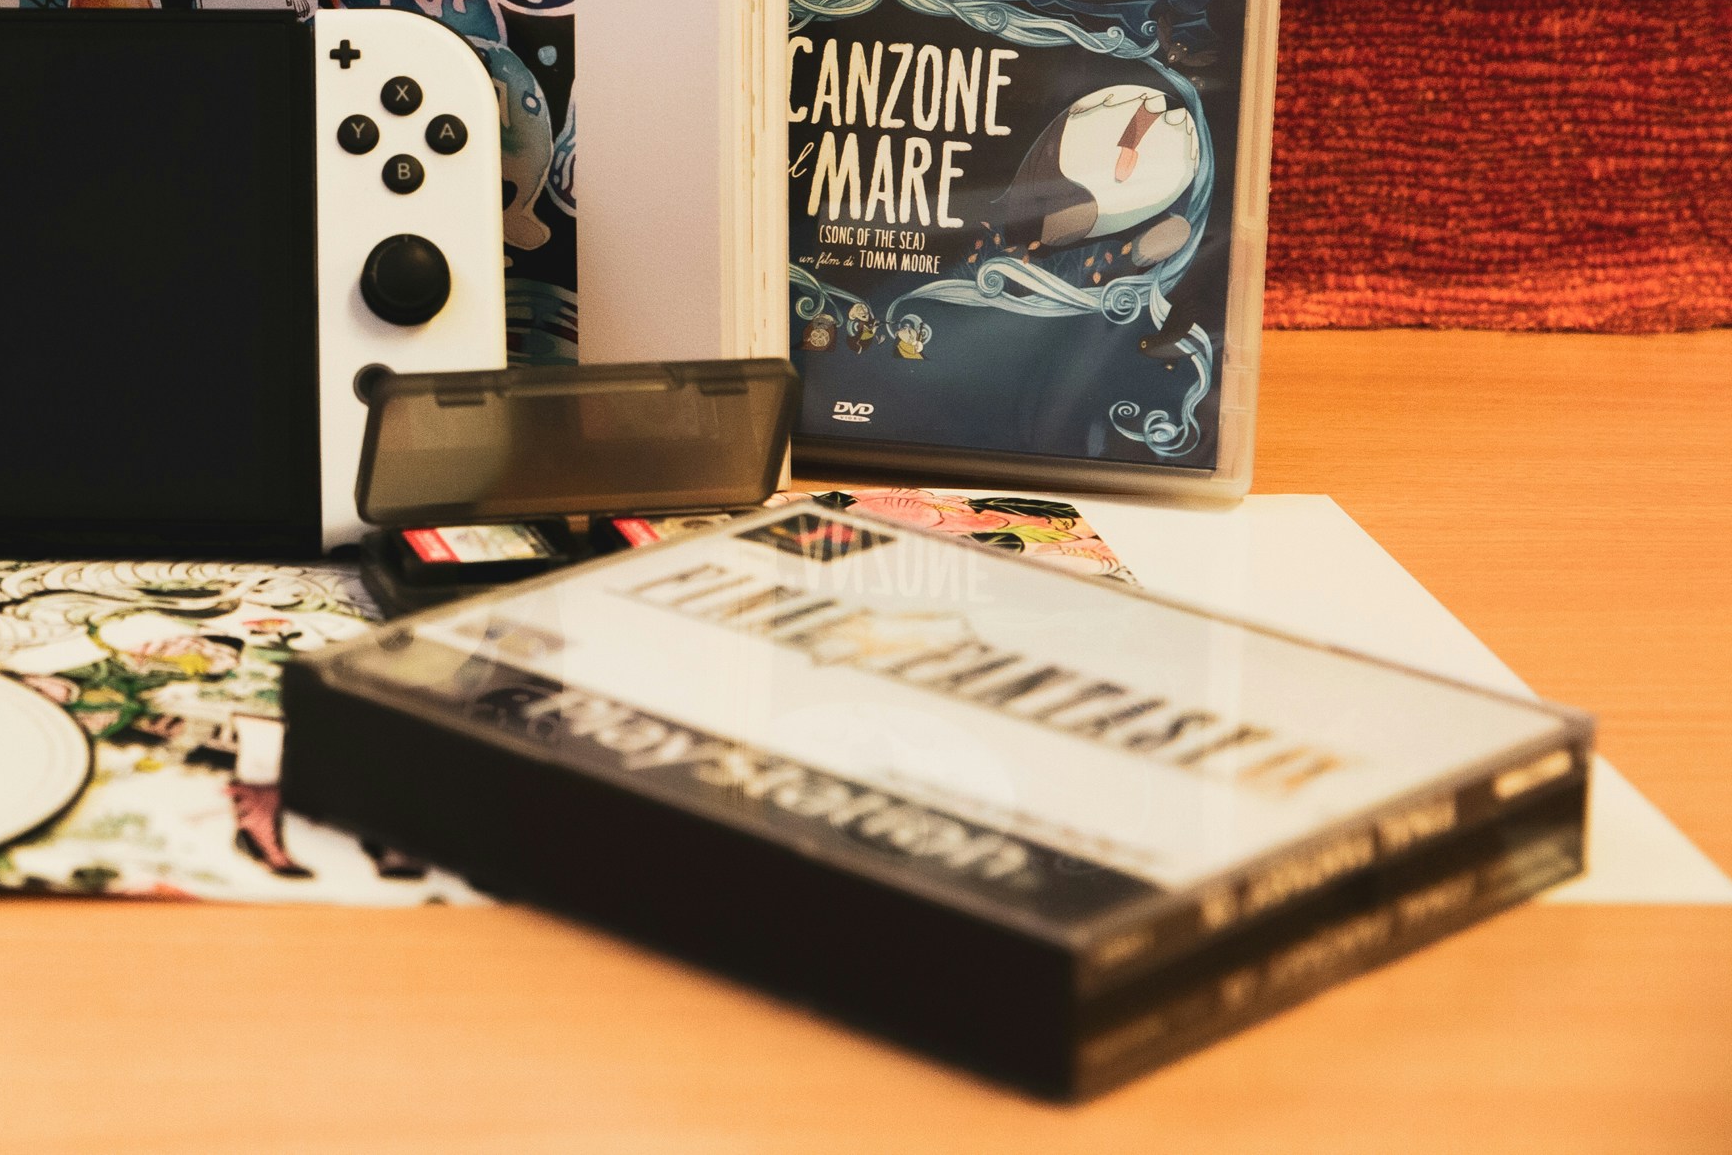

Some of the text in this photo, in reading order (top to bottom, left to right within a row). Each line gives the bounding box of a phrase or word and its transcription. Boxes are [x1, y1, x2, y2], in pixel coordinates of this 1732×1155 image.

[395, 84, 410, 102] X
[788, 36, 1019, 136] CANZONE
[351, 122, 366, 139] Y
[439, 123, 456, 139] A
[397, 162, 411, 180] B
[807, 131, 972, 228] MARE
[819, 225, 926, 251] (SONG OF THE SEA)
[799, 249, 941, 274] un film di TOMM MOORE
[833, 401, 874, 415] DVD
